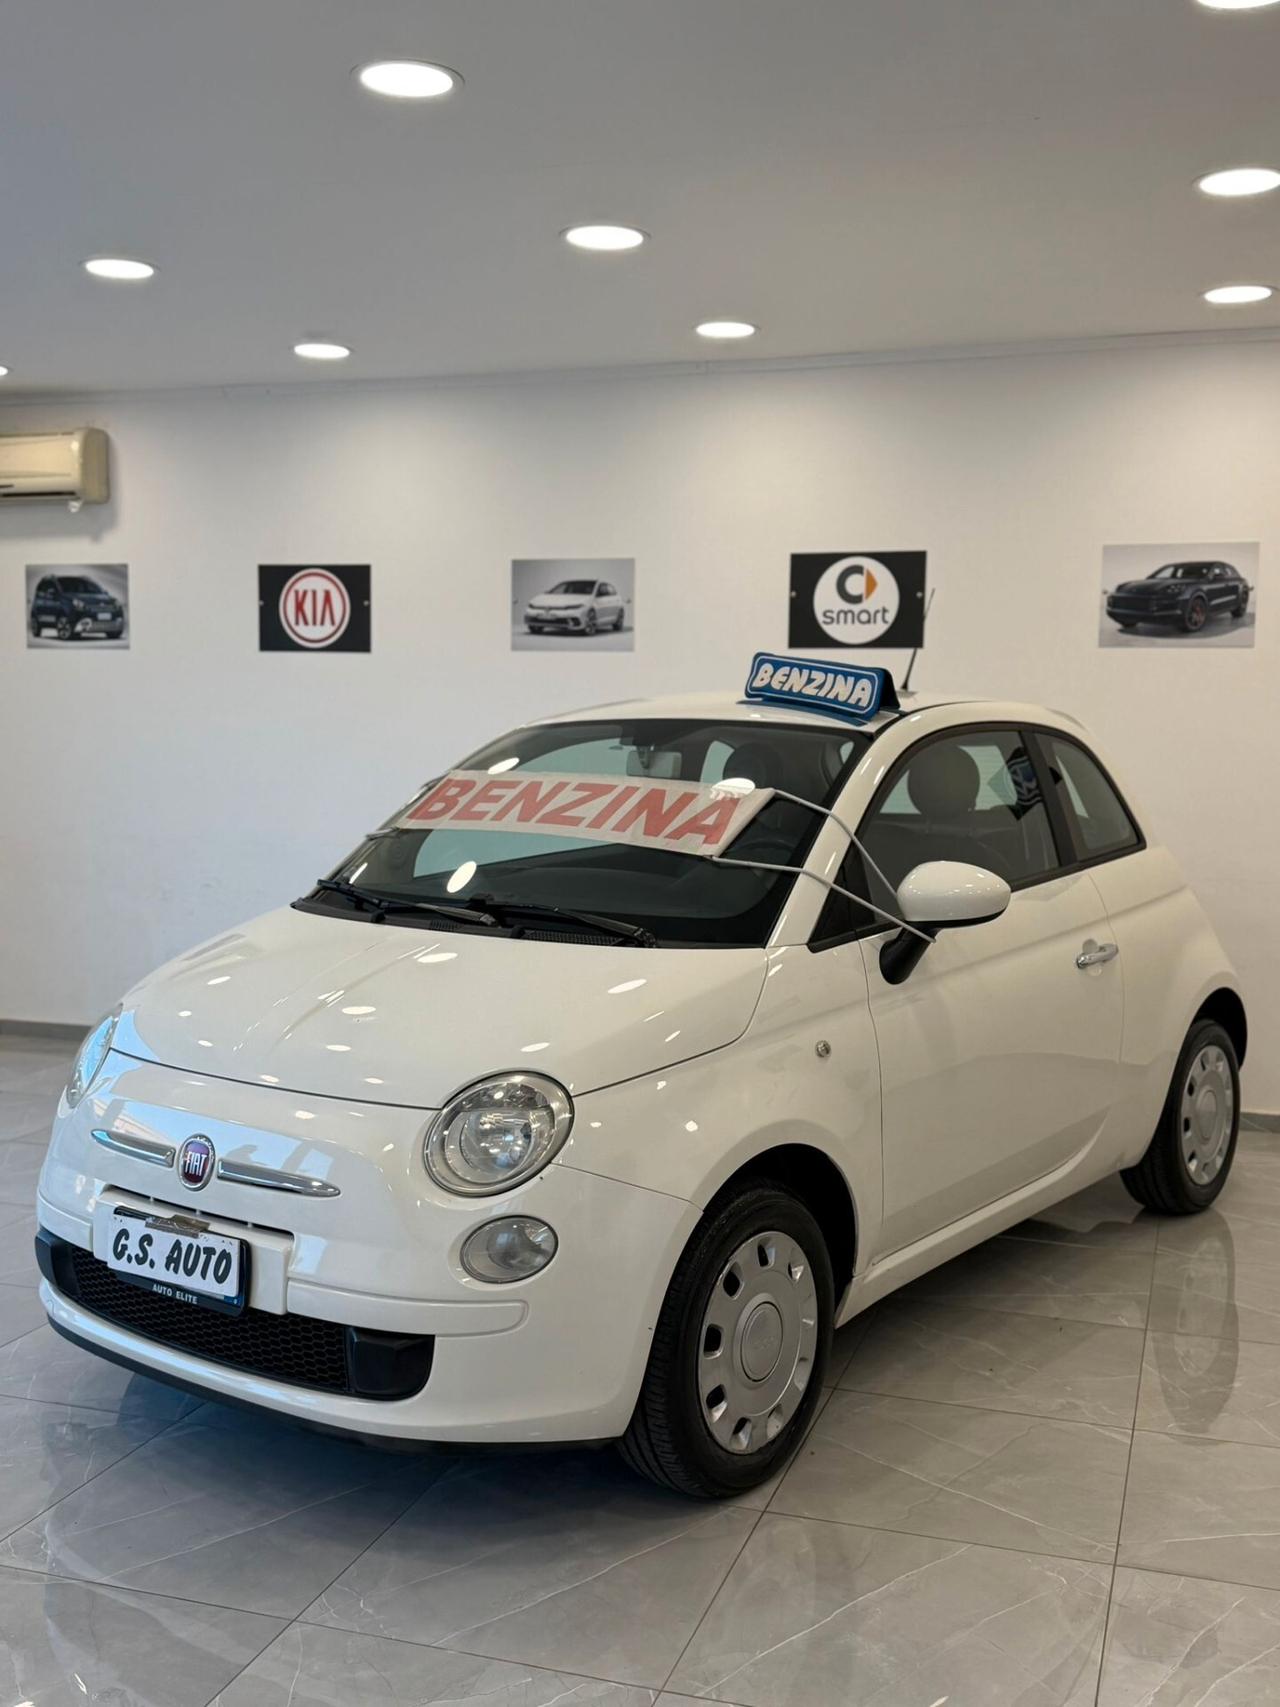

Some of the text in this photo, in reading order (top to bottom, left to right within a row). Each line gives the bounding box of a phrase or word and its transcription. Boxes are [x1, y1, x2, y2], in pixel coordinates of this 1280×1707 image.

[293, 589, 336, 626] KIA
[821, 606, 890, 625] smart
[752, 662, 872, 708] BENZINA
[405, 777, 742, 845] BENZINA
[184, 1150, 208, 1177] FIAT
[112, 1228, 232, 1284] G.S. AUTO
[152, 1283, 198, 1305] AUTO ELITE
